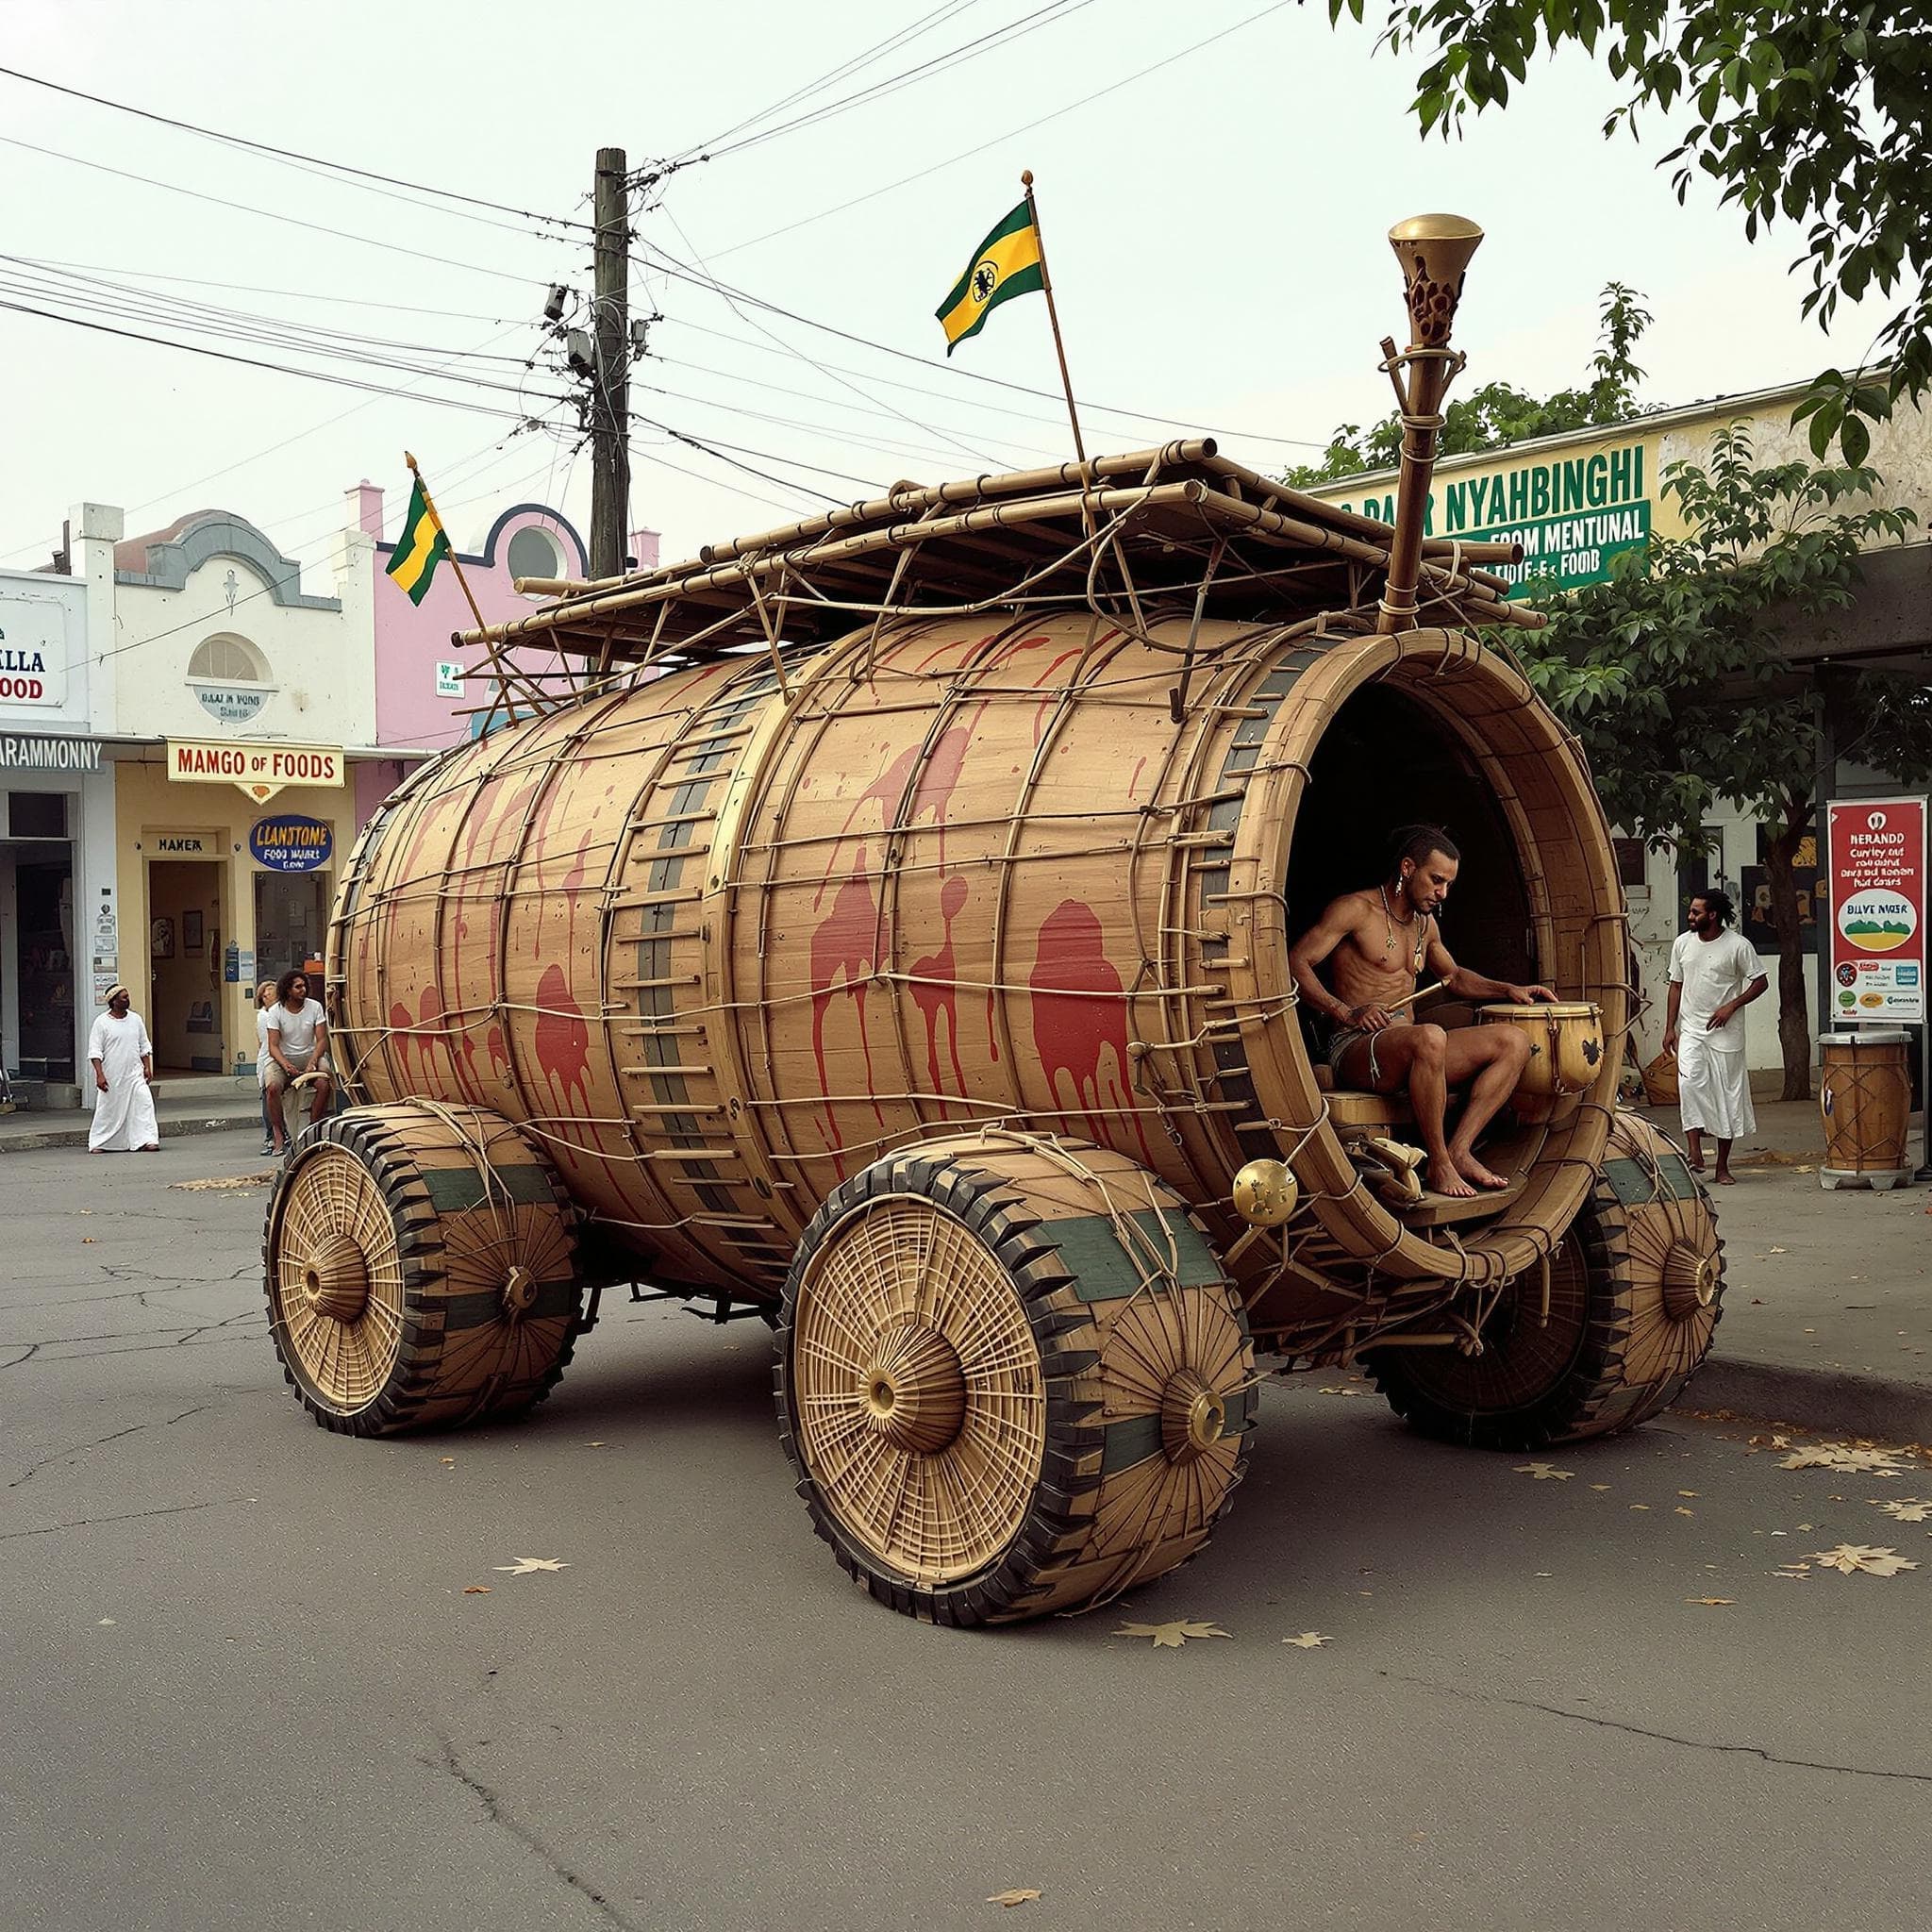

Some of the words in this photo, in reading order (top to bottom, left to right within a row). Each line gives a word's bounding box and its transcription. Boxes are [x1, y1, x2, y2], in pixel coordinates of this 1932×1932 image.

[1446, 444, 1644, 532] NYAHBINGHI
[1544, 509, 1644, 555] MENTUNAL
[0, 649, 45, 672] LLA
[251, 757, 267, 772] OF
[273, 754, 334, 778] FOODS
